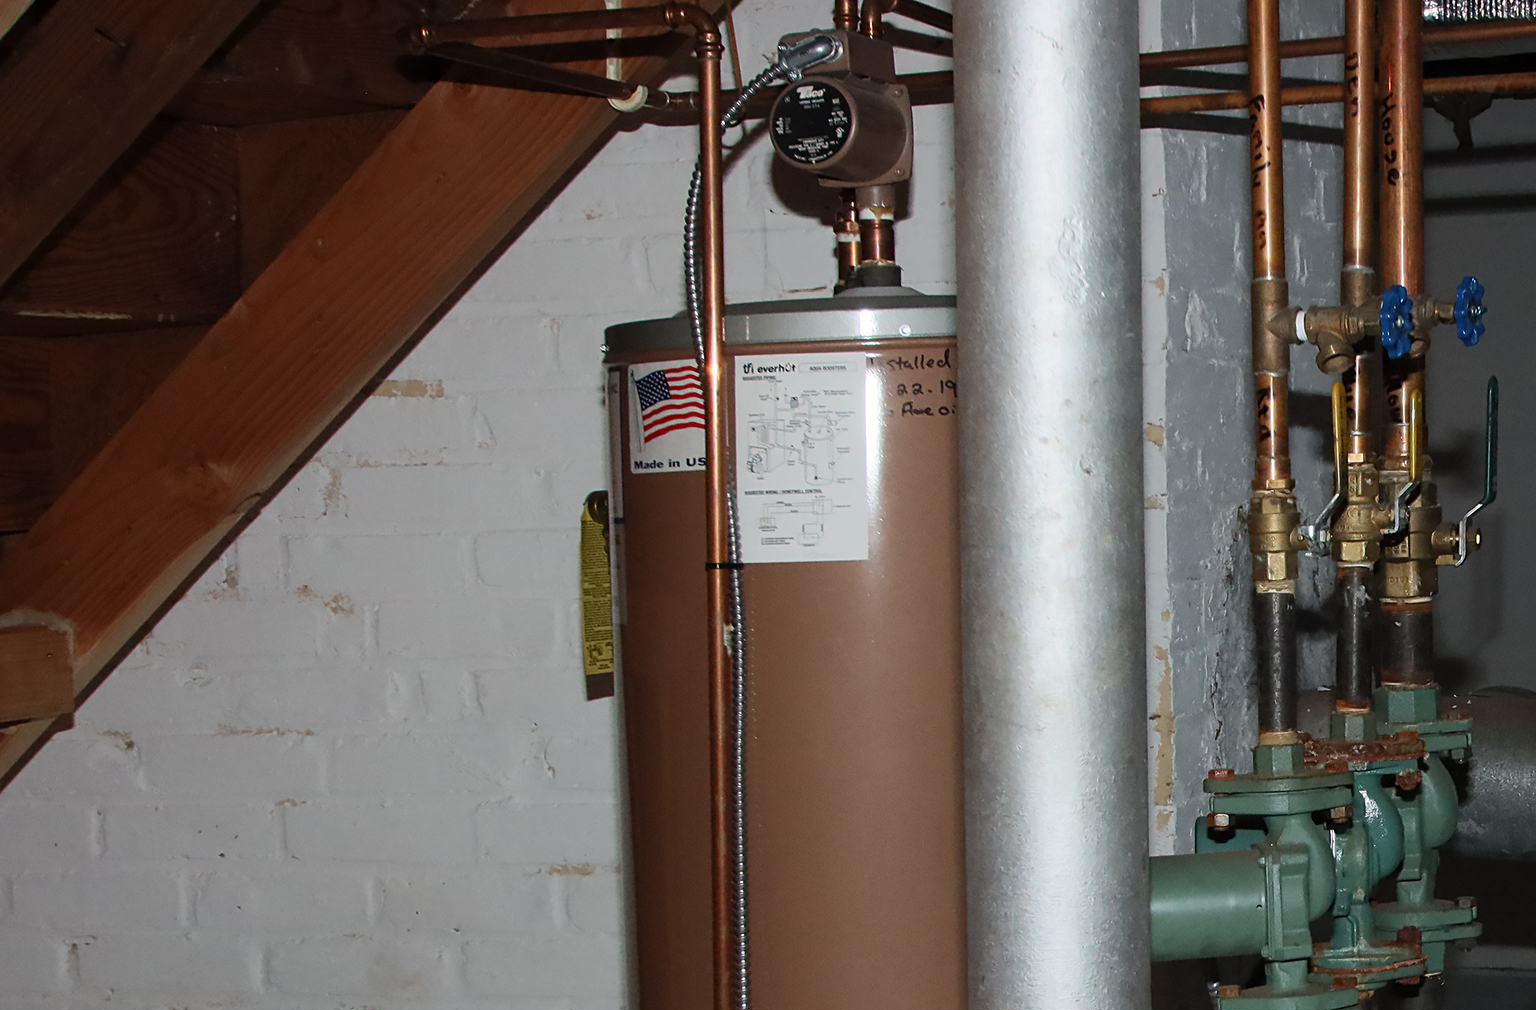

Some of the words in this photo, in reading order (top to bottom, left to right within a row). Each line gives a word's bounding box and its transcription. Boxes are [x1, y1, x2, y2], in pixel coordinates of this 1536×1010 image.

[796, 85, 824, 99] Taco
[1381, 92, 1400, 186] House
[870, 348, 951, 371] Istalled
[634, 460, 664, 470] Made
[668, 459, 680, 468] in
[686, 457, 707, 467] US
